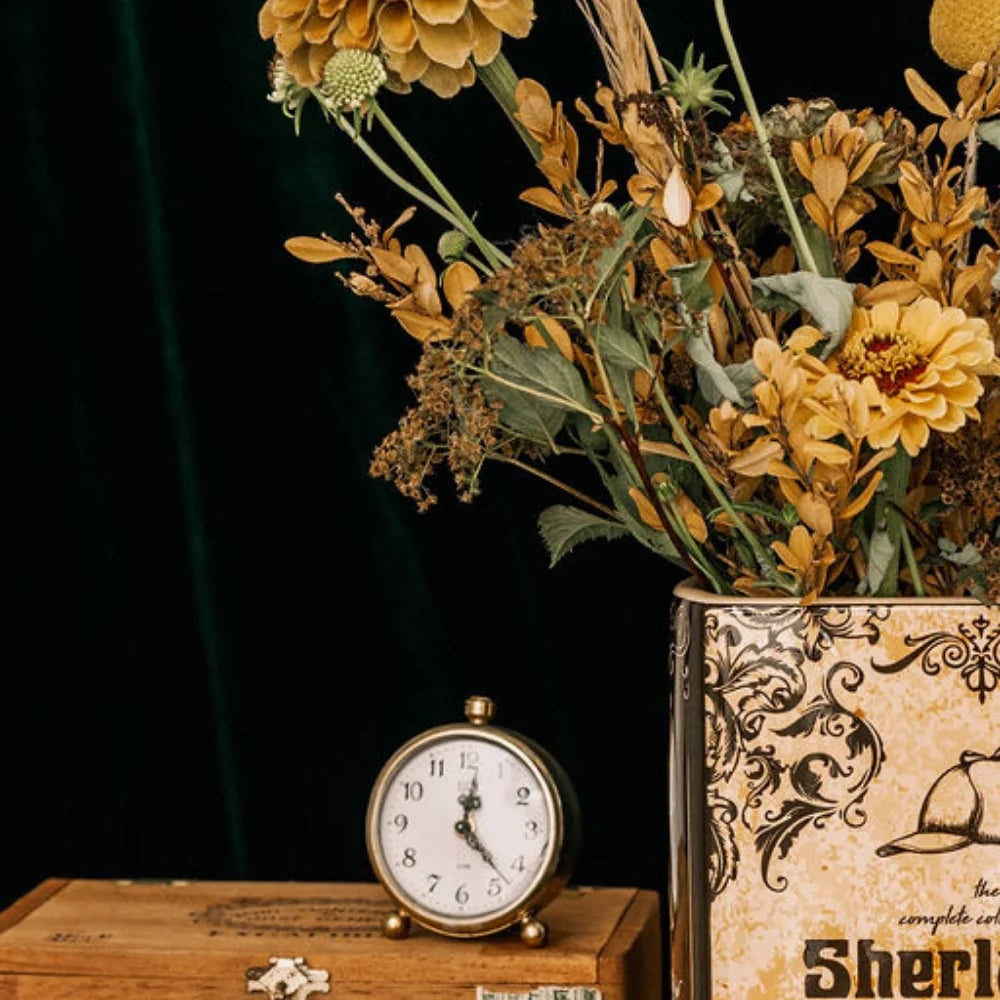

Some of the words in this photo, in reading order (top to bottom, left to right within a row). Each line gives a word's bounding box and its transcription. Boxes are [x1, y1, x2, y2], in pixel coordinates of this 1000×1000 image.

[429, 759, 444, 777] 11
[403, 781, 423, 800] 10
[394, 814, 408, 833] 9
[525, 820, 538, 840] 3
[402, 848, 416, 868] 8
[427, 874, 441, 893] 7
[487, 878, 502, 896] 5
[974, 877, 1000, 899] the
[455, 885, 469, 904] 6
[898, 904, 973, 936] complete
